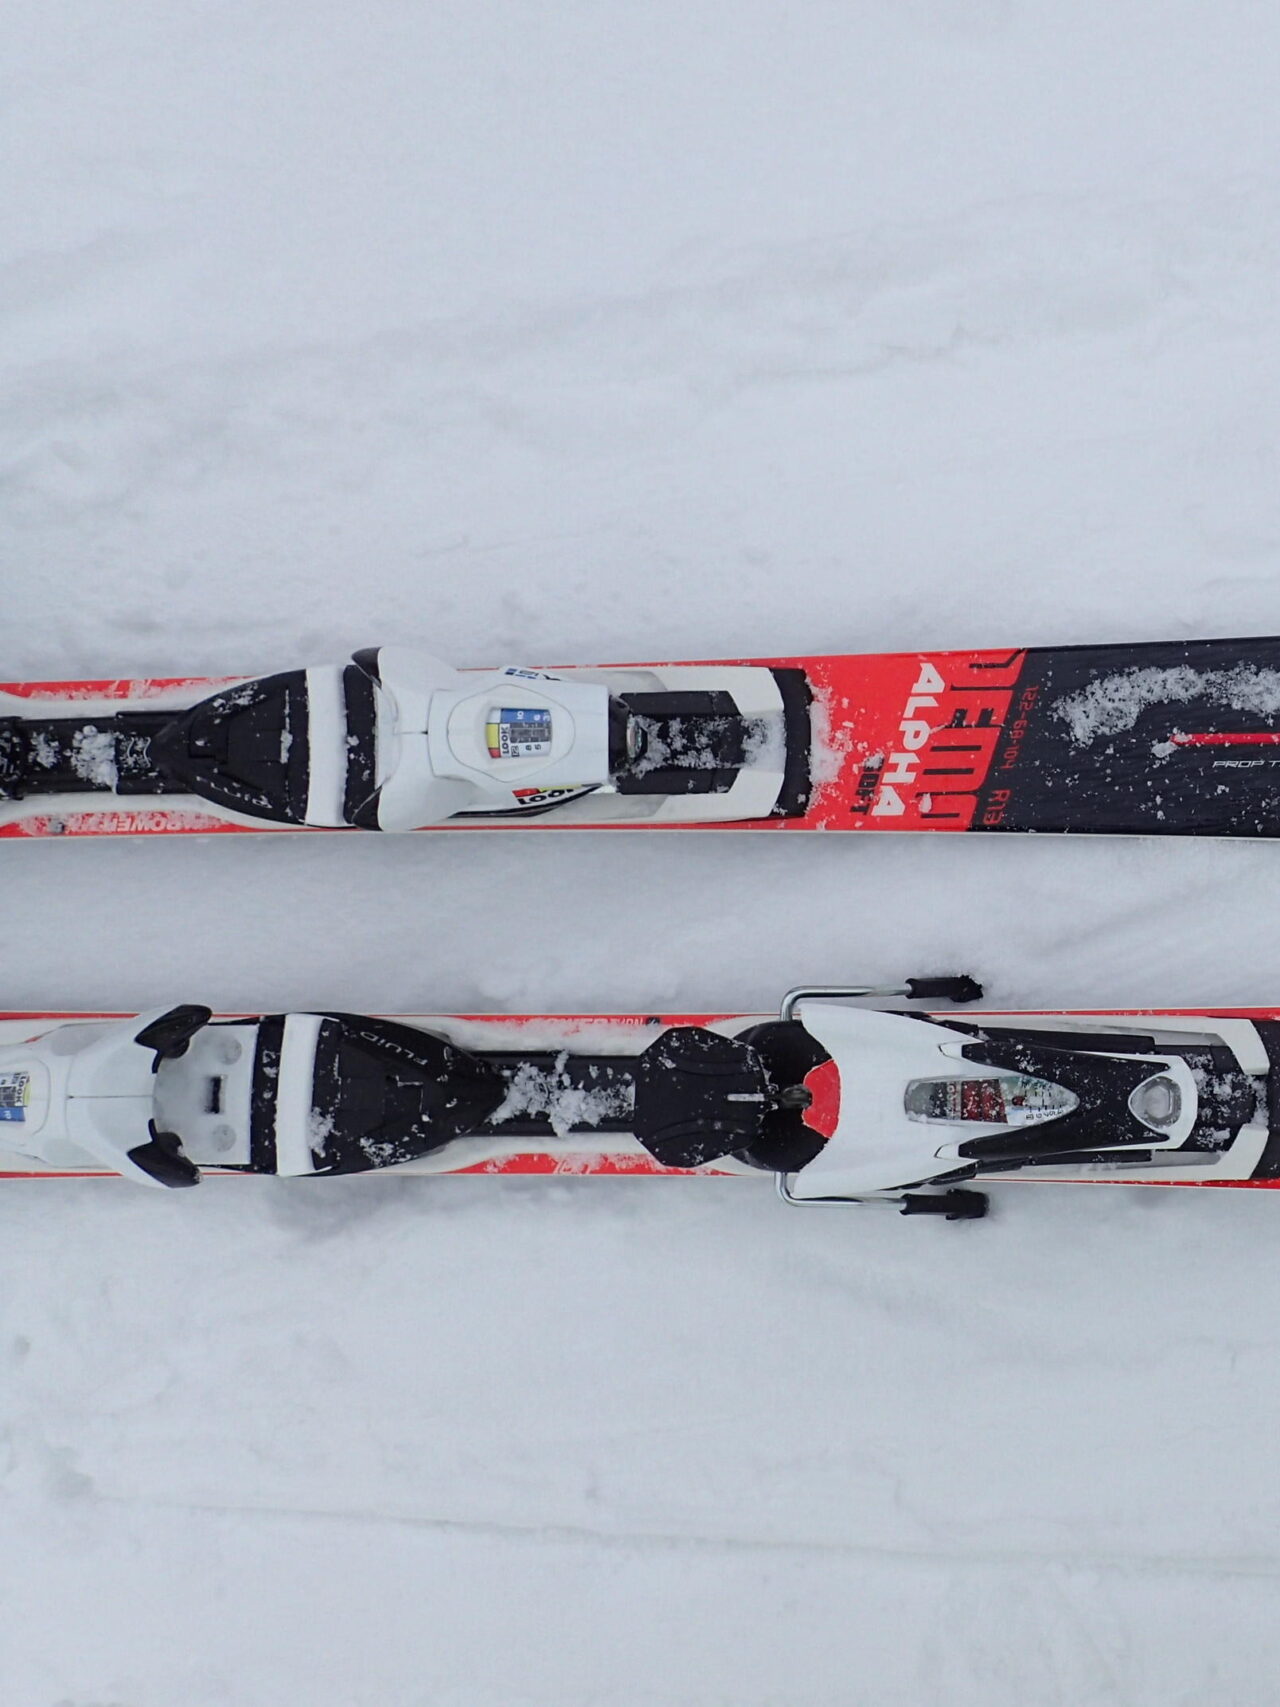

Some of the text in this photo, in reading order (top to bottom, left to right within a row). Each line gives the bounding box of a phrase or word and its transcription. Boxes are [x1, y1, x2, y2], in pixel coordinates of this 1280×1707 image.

[501, 726, 510, 754] LOOK
[871, 663, 945, 816] ALPHA
[1212, 760, 1265, 768] PROP
[983, 790, 1011, 825] R13
